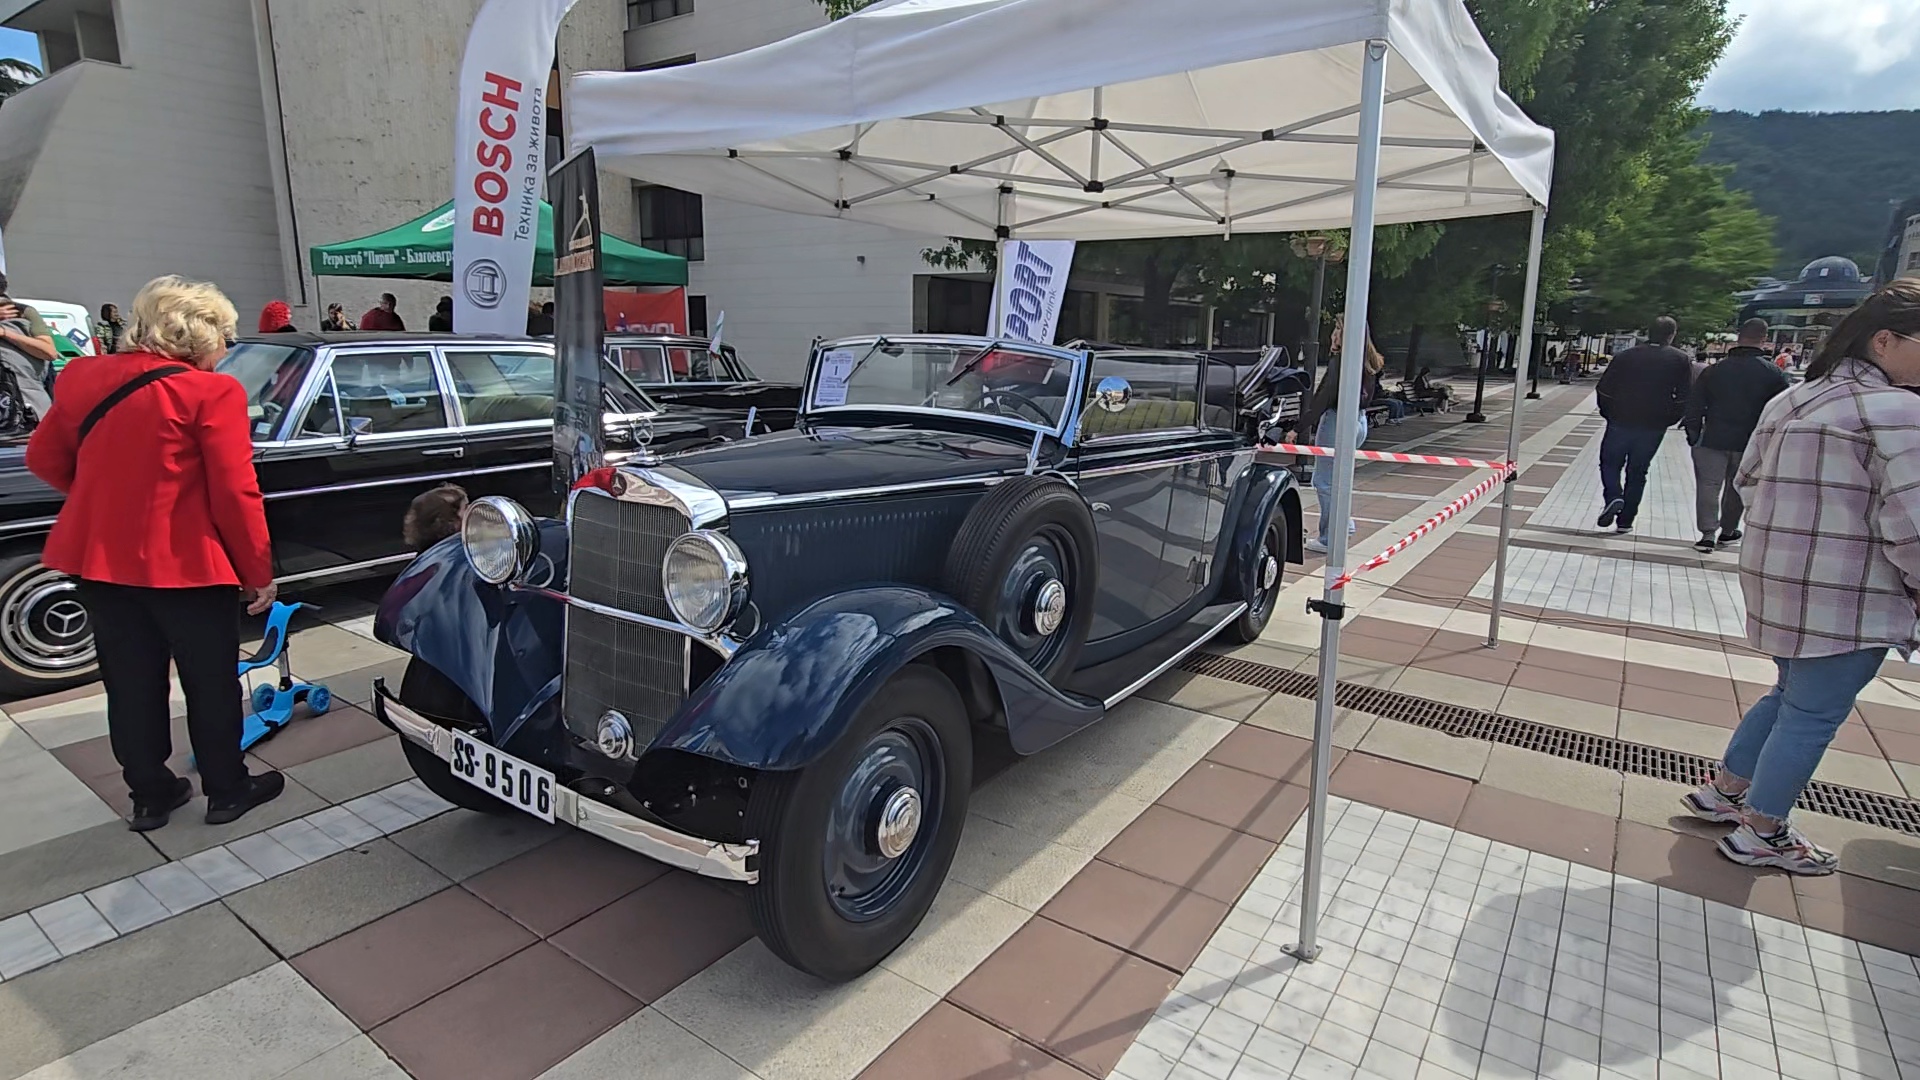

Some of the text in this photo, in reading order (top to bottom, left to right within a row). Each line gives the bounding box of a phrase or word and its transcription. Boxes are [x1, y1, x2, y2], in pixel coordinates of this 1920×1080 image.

[473, 71, 522, 236] BOSCH
[514, 87, 542, 241] Техника за живота
[322, 251, 344, 269] Ретро
[345, 251, 363, 268] клуб
[406, 248, 454, 266] Благоевгр
[1003, 240, 1053, 343] PORT
[453, 737, 550, 815] SS-9506
